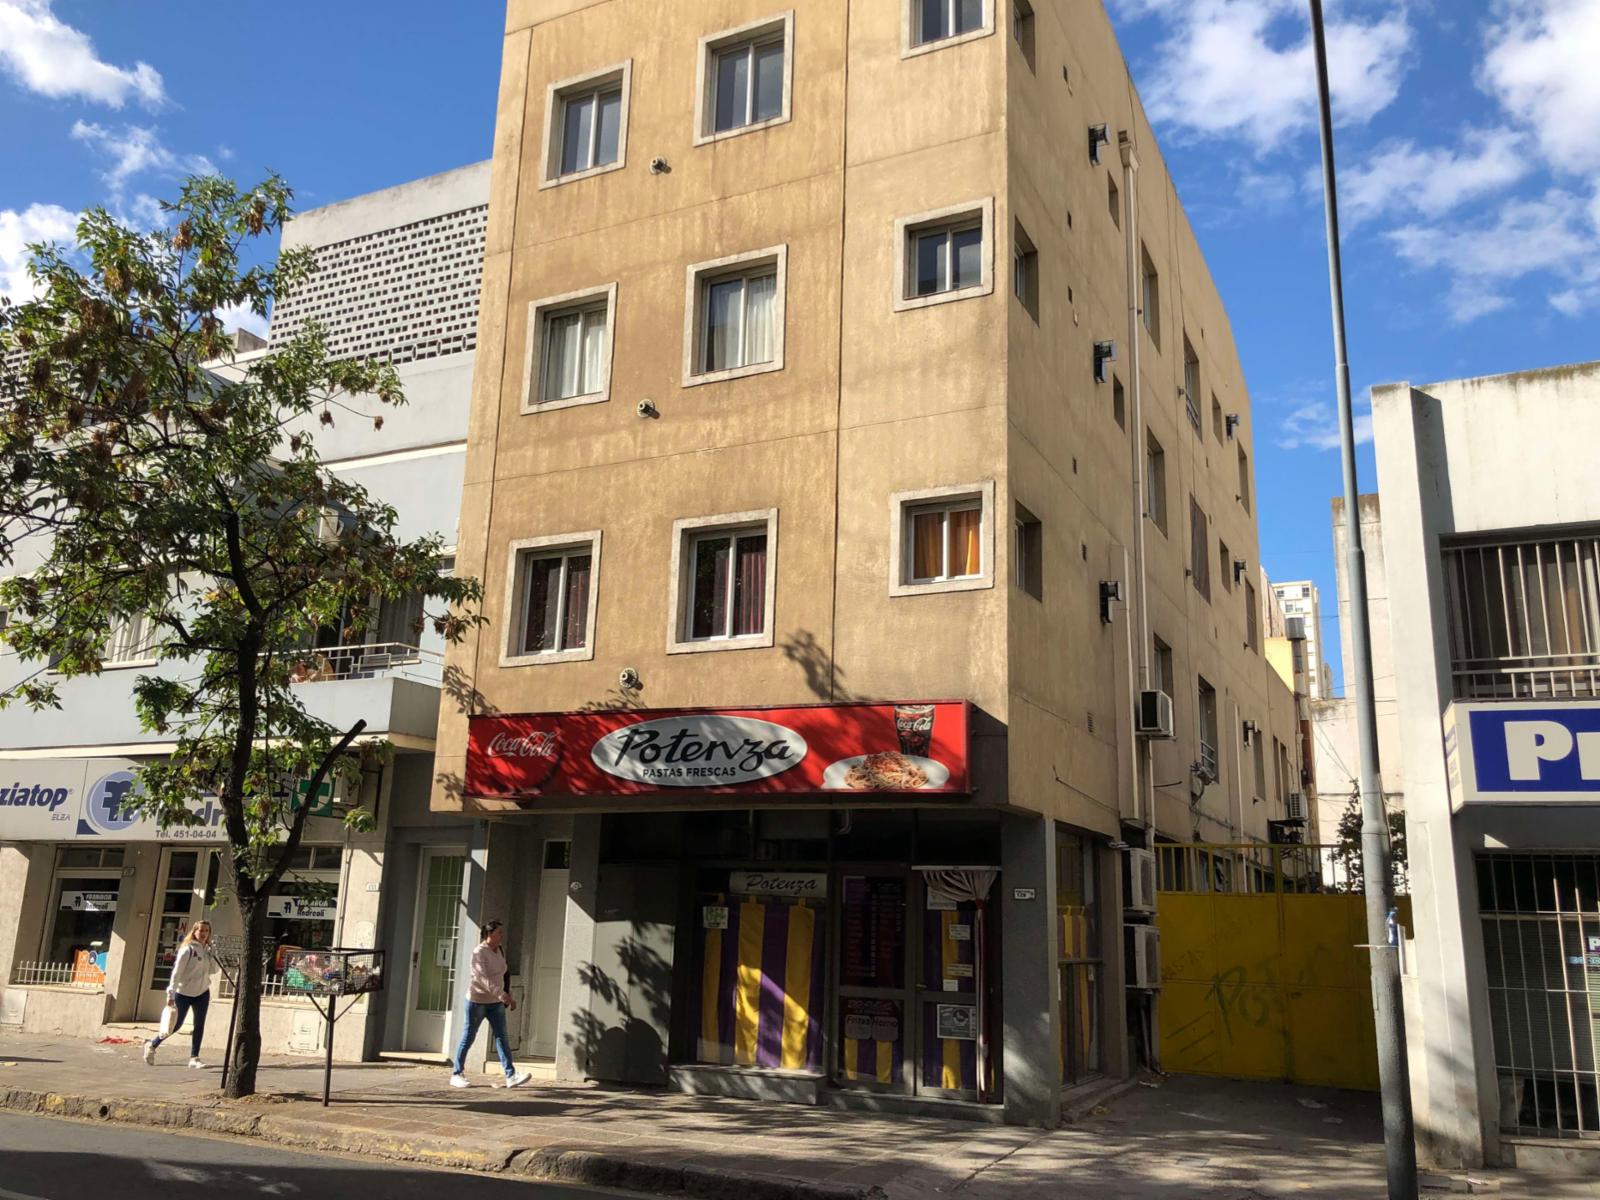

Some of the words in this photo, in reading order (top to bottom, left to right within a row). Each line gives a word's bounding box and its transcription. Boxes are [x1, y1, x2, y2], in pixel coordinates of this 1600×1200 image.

[614, 728, 794, 772] Potenza
[642, 768, 683, 778] PASTAS
[686, 766, 737, 777] FRESCAS
[155, 830, 171, 838] Tel.
[173, 830, 217, 839] 451-04-04
[746, 873, 817, 895] Potenza
